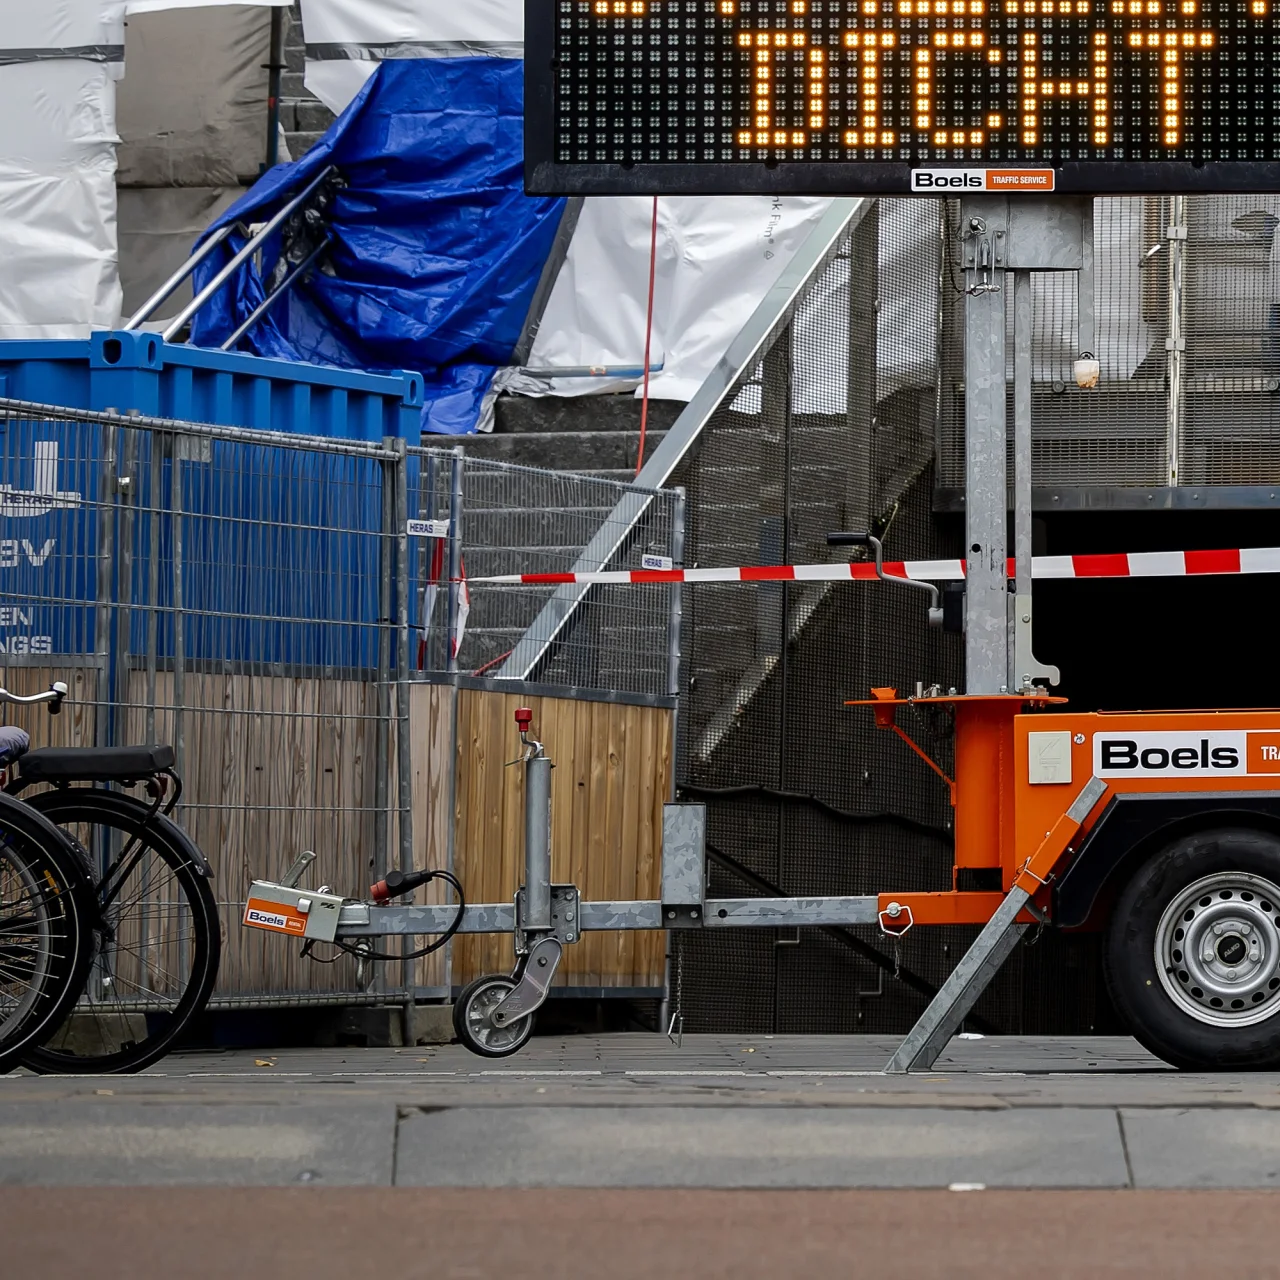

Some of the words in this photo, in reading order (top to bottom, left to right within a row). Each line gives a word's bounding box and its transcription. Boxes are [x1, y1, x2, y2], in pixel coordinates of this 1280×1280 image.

[739, 32, 1213, 144] DICHT
[916, 173, 982, 187] Boels
[993, 176, 1018, 184] TRAFFIC
[1020, 176, 1047, 184] SERVICE
[410, 523, 433, 533] HERAS
[1102, 740, 1238, 769] Boels
[249, 911, 284, 926] Boels
